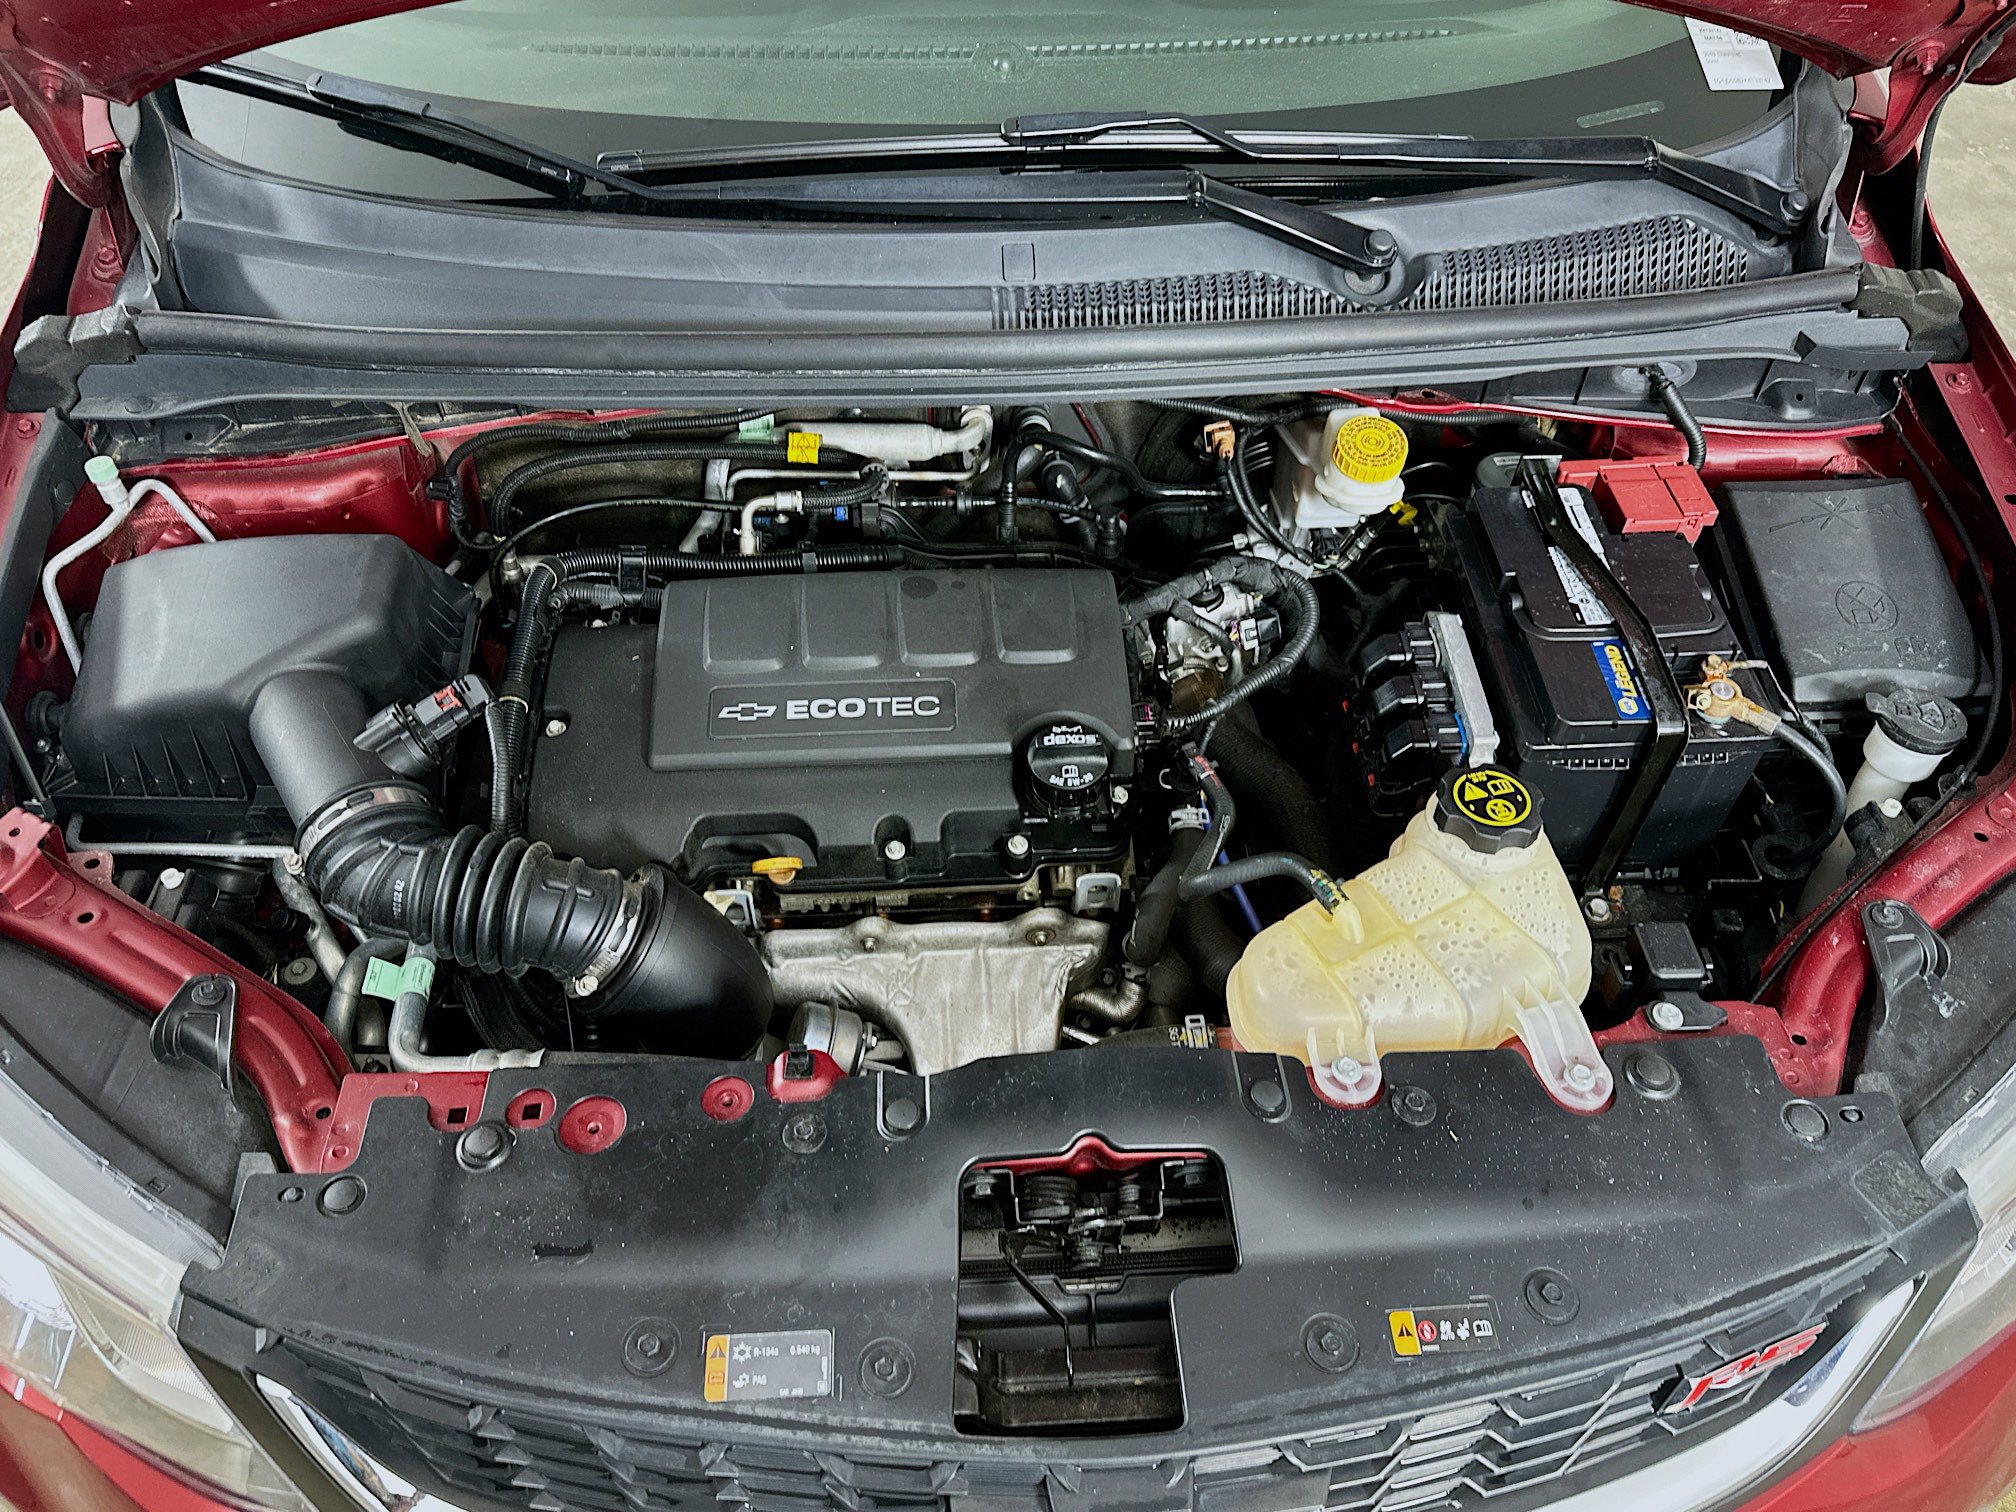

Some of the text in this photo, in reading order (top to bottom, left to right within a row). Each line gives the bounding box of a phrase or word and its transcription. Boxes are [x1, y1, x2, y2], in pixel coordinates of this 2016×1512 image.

[1604, 645, 1638, 698] LEGEND
[786, 695, 941, 720] ECOTEC
[1043, 733, 1097, 746] dexos
[1665, 1322, 1828, 1414] RS
